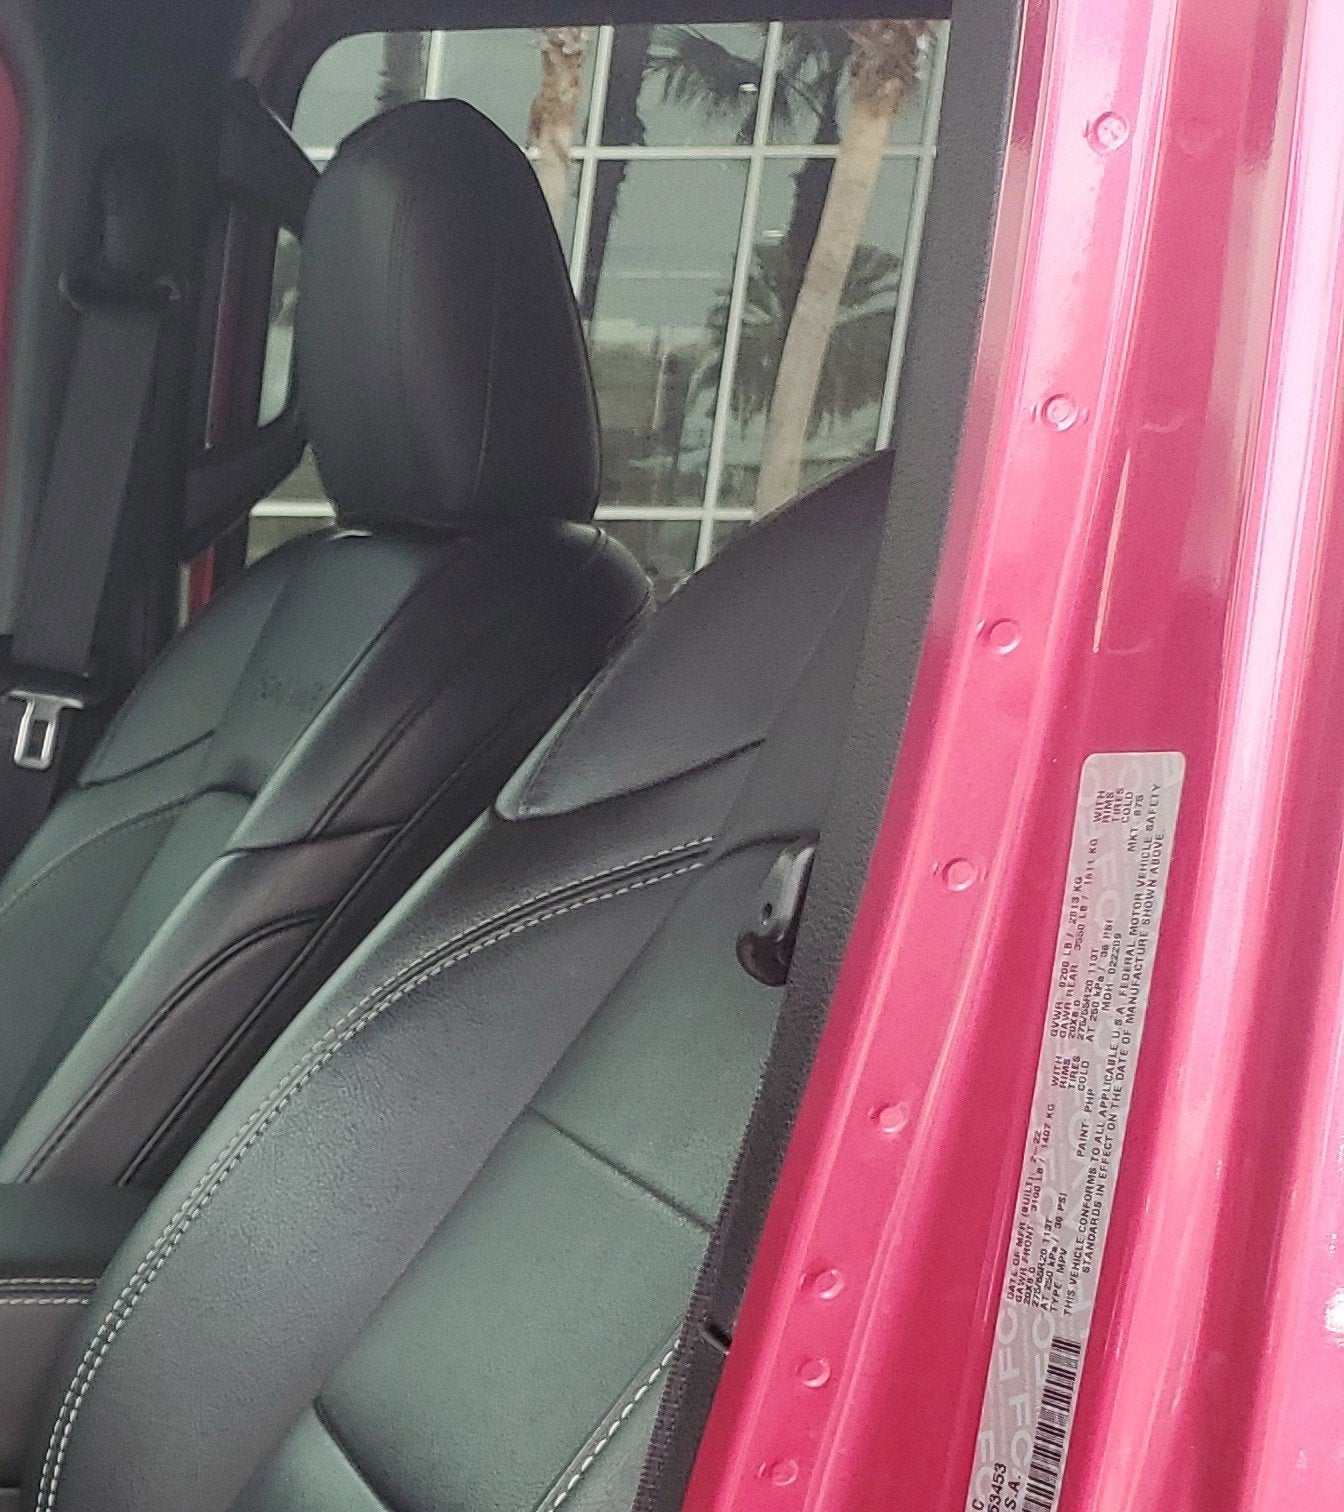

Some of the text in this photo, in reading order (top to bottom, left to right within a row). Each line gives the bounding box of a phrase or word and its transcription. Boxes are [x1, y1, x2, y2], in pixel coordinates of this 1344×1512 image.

[1144, 783, 1161, 831] SAFETY
[1135, 835, 1153, 886] VEHICLE
[1128, 892, 1144, 935] MOTOR
[1141, 878, 1157, 925] SHOWN
[1118, 939, 1136, 996] FEDERAL
[1124, 931, 1149, 1023] MANUFACTURE
[1121, 1028, 1132, 1045] OF
[1051, 1055, 1062, 1086] WITH
[1077, 1059, 1089, 1091] COLD
[1098, 1043, 1118, 1117] APPLICABLE
[1115, 1049, 1128, 1080] DATE
[1110, 1084, 1122, 1108] THE
[1094, 1121, 1105, 1143] ALL
[1106, 1113, 1117, 1130] ON
[1090, 1146, 1100, 1162] TO
[1098, 1134, 1113, 1179] EFFECT
[1056, 1247, 1068, 1273] MPV
[1083, 1088, 1095, 1112] PHP
[1078, 1165, 1097, 1233] CONFORMS
[1095, 1183, 1104, 1196] IN
[1081, 1200, 1102, 1273] STANDARDS
[1069, 1236, 1085, 1285] VEHICLE
[1063, 1288, 1076, 1316] THIS
